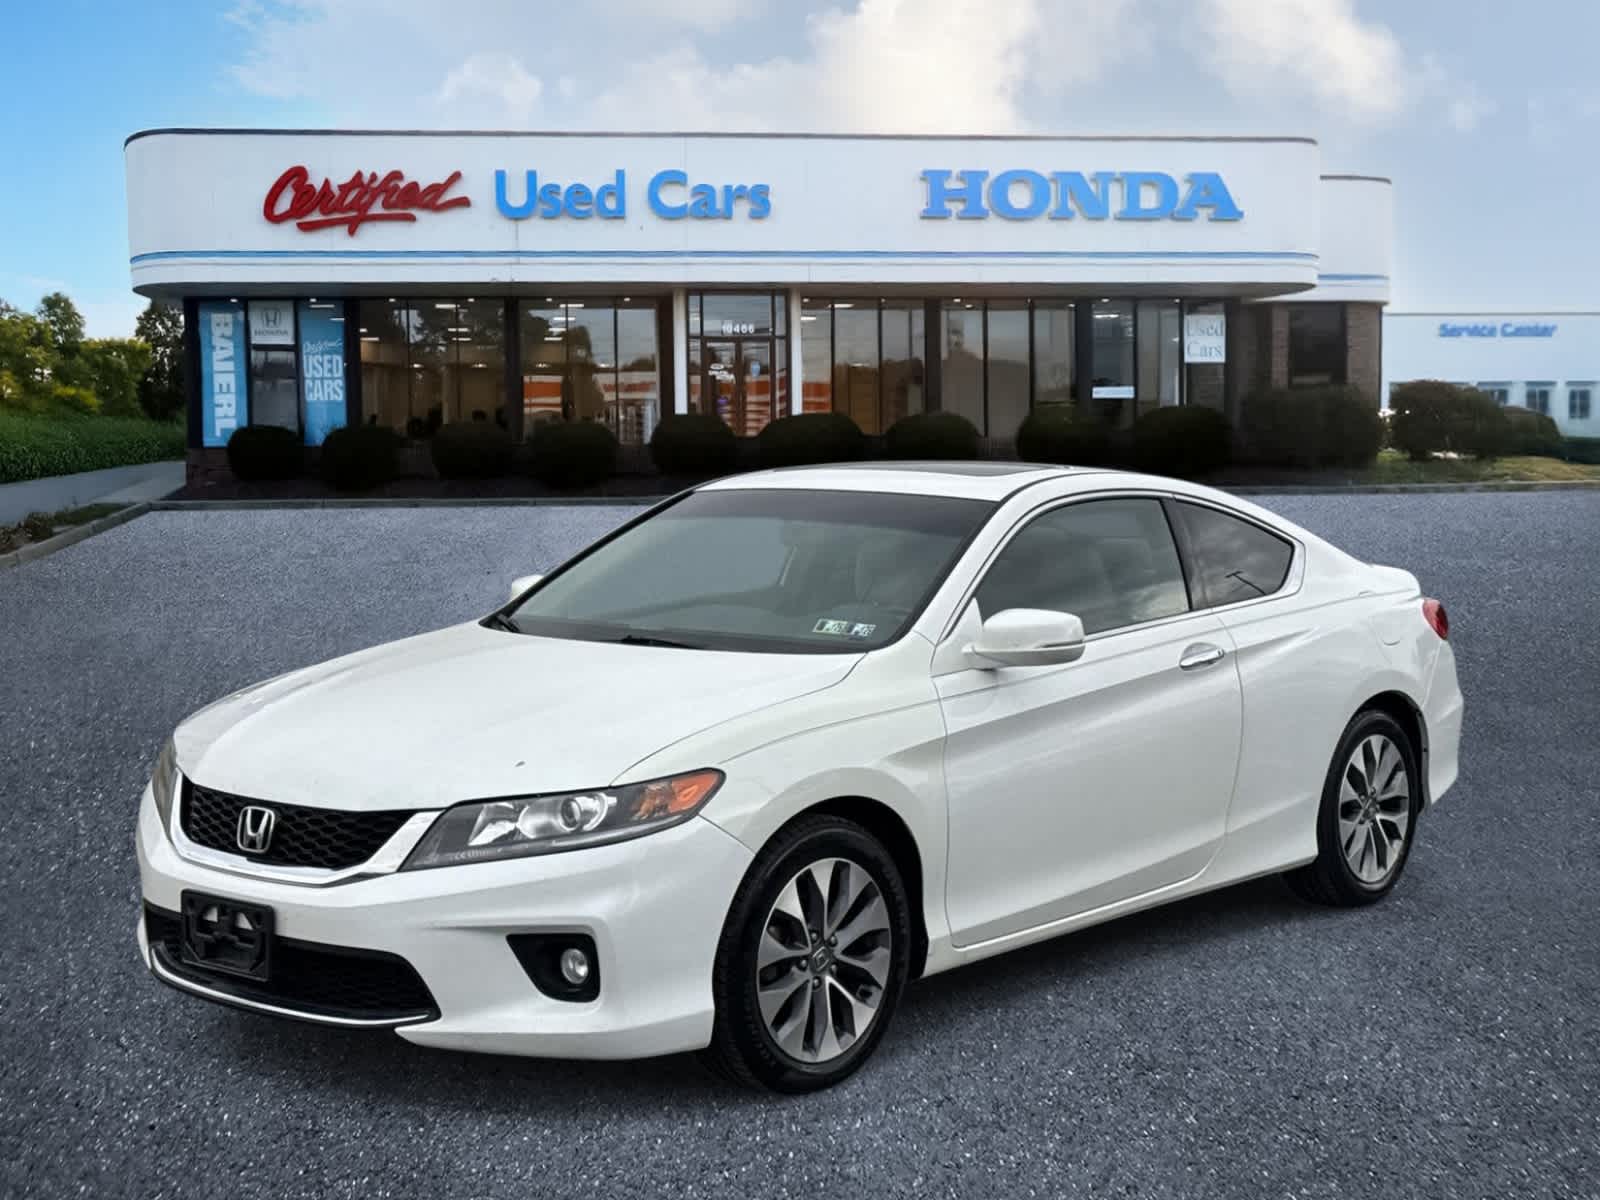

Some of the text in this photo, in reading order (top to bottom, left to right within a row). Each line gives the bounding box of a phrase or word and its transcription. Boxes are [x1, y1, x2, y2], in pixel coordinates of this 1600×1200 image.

[263, 165, 772, 236] Certified Used Cars
[919, 169, 1245, 221] HONDA
[1186, 319, 1224, 337] Used
[1438, 322, 1558, 338] Service Center
[1186, 341, 1223, 358] Cars
[211, 312, 237, 437] BAIERL
[303, 354, 342, 378] USED
[304, 379, 343, 402] CARS
